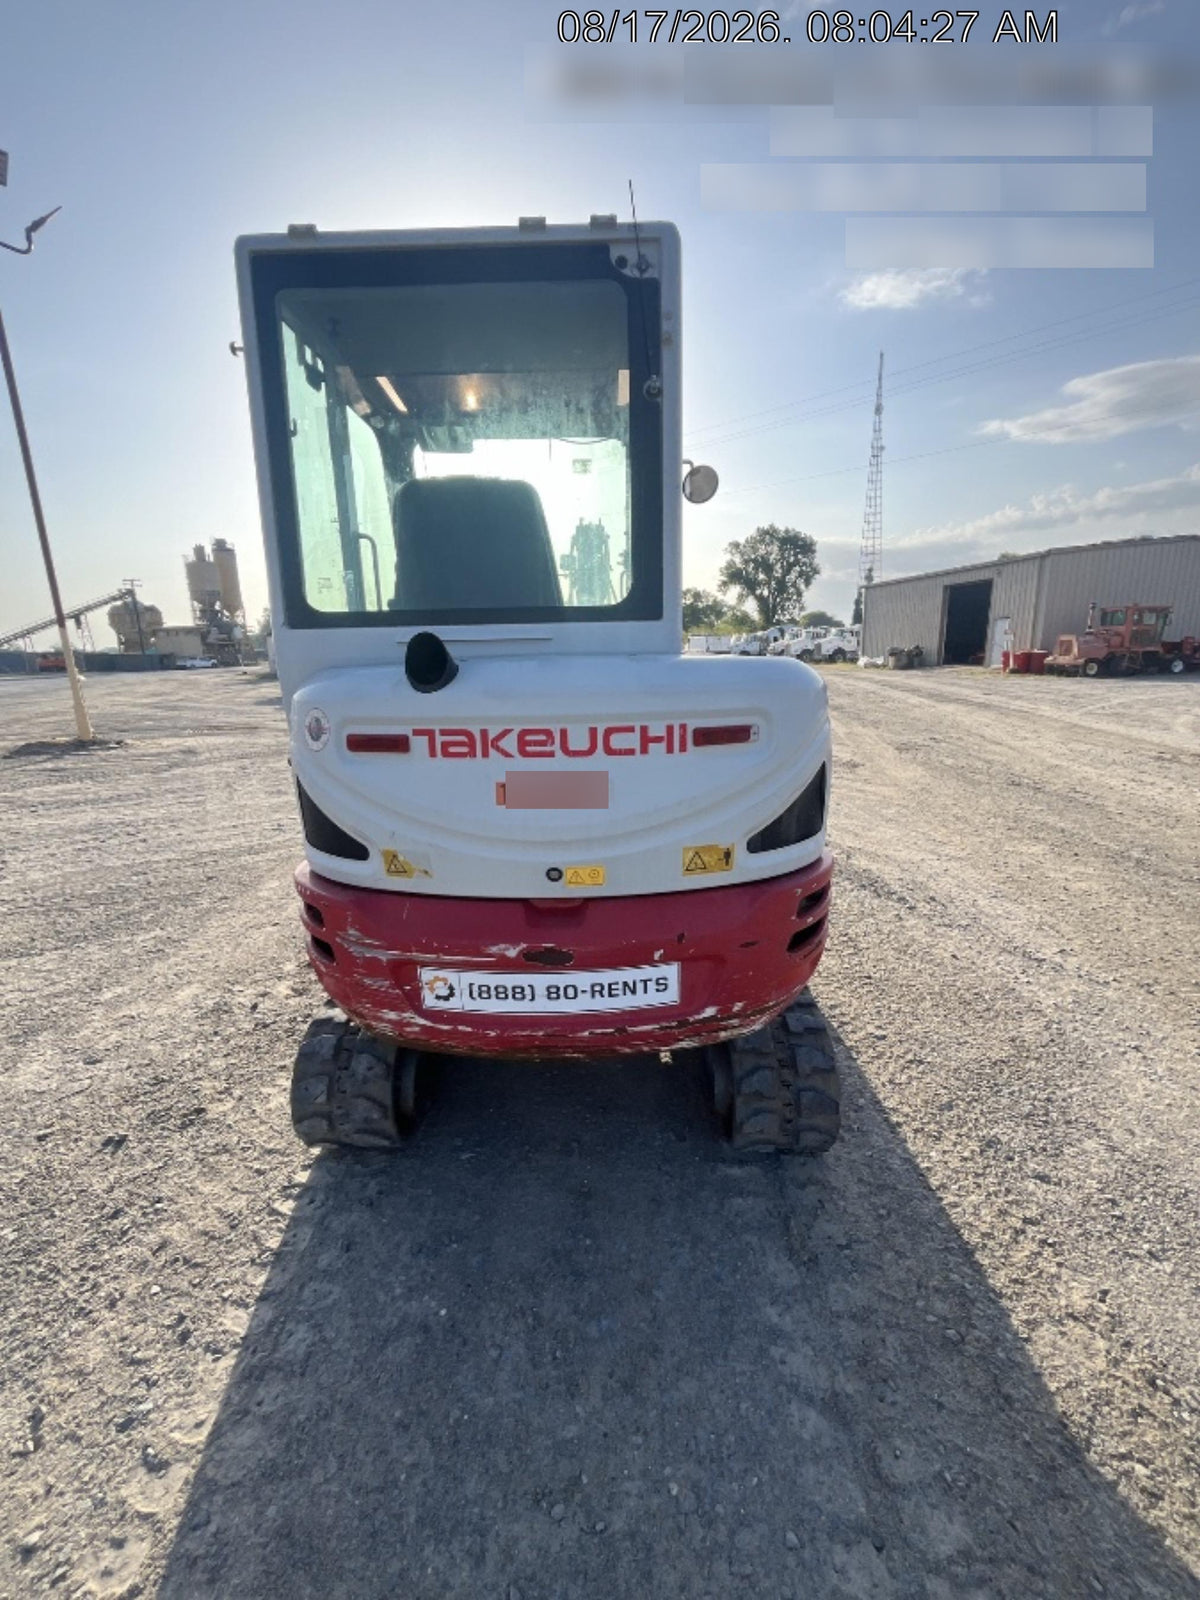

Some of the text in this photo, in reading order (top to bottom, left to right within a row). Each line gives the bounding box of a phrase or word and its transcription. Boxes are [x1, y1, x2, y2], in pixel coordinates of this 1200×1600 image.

[412, 723, 687, 759] TAKEUCHI
[468, 976, 669, 1002] (888) 80-RENTS
